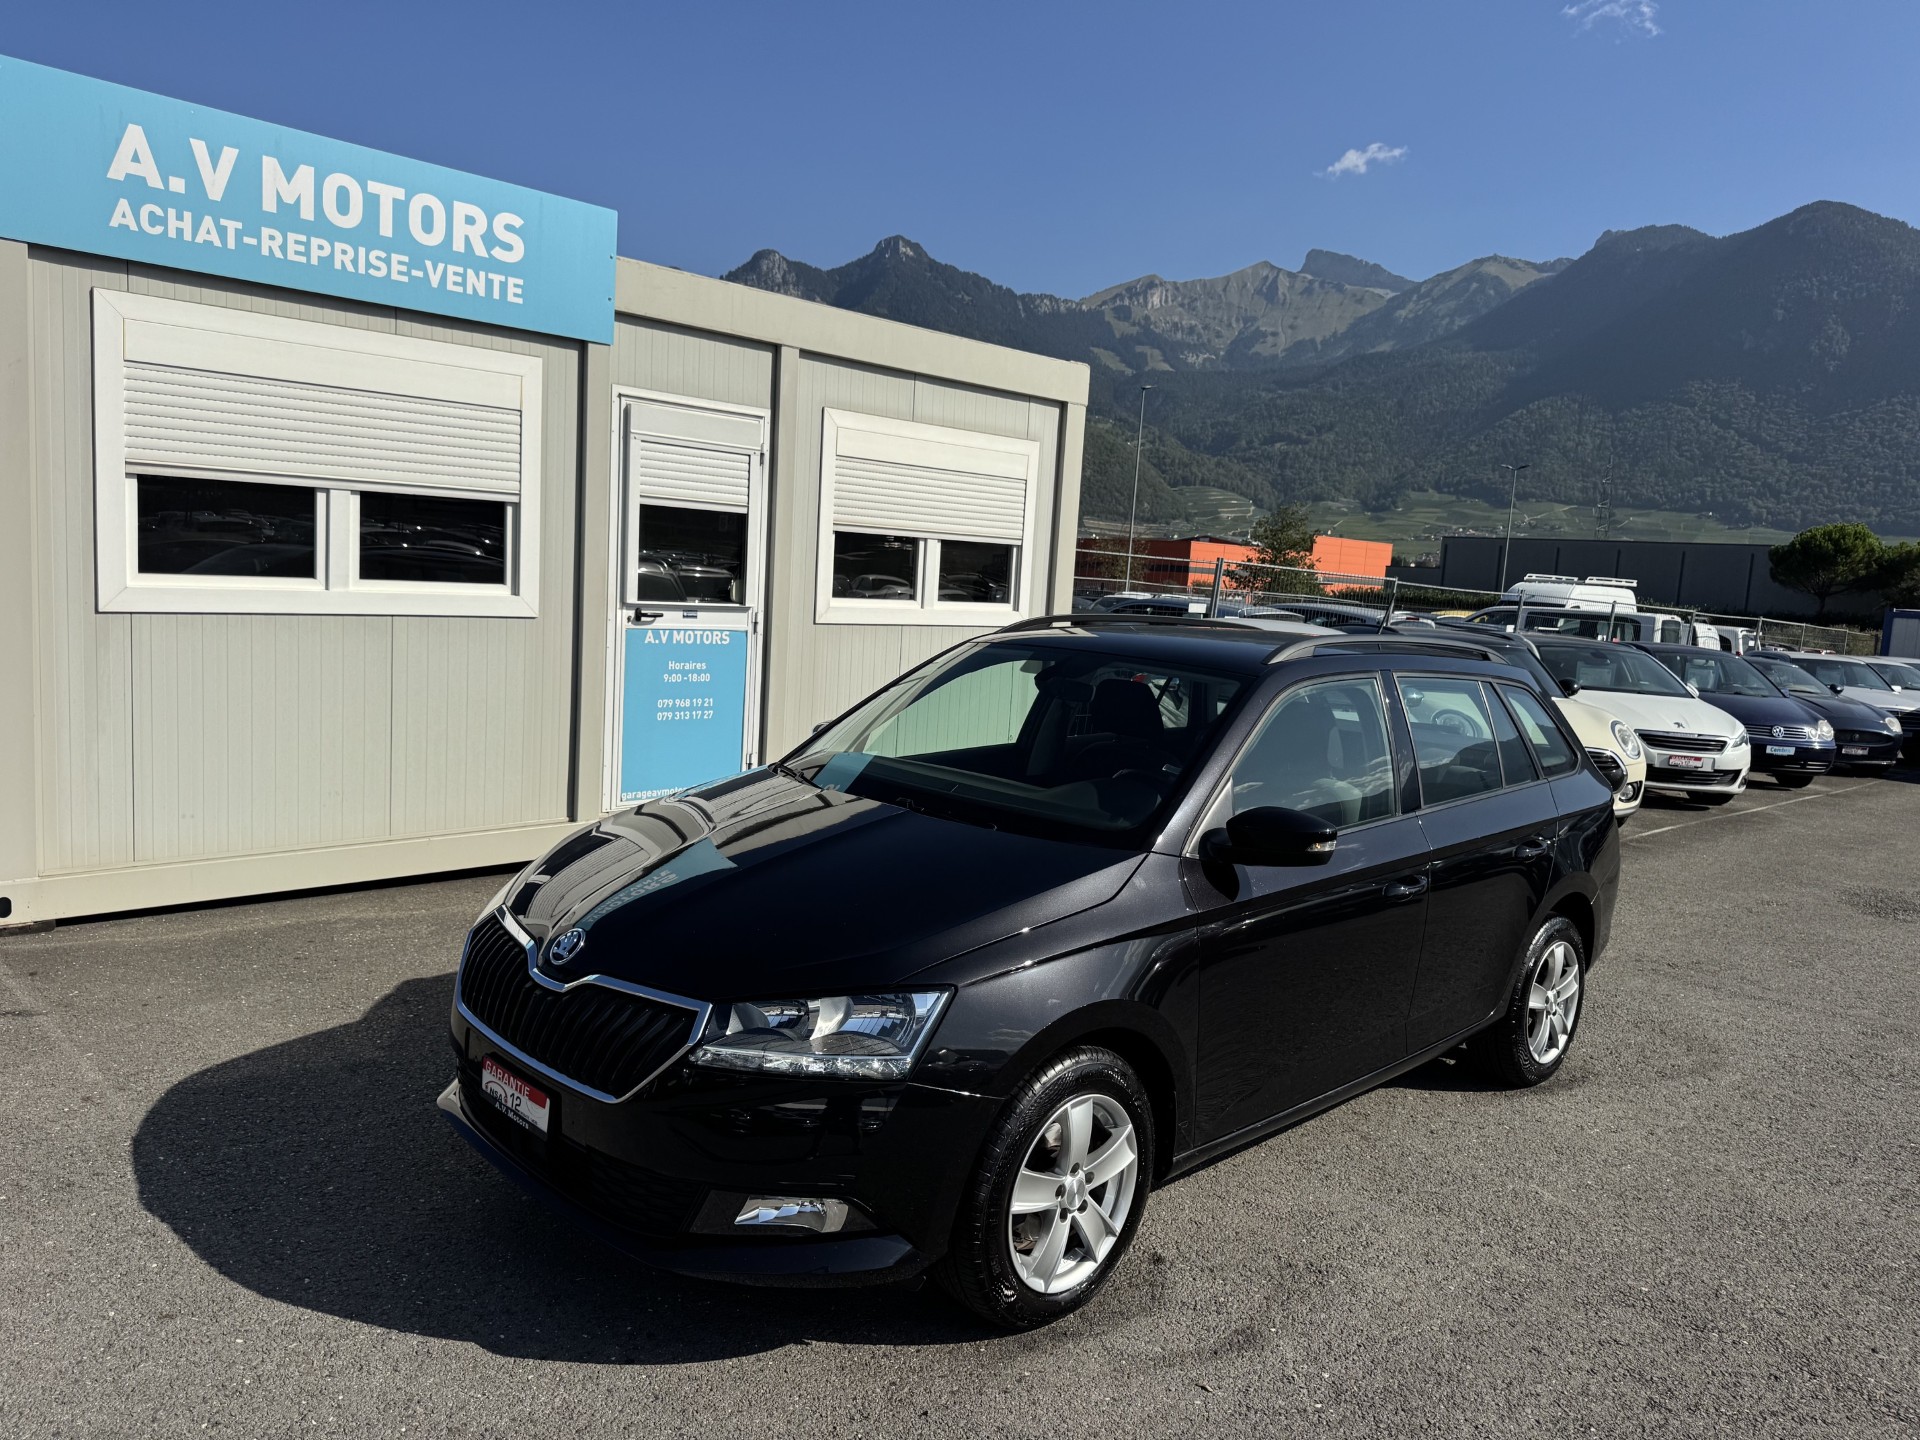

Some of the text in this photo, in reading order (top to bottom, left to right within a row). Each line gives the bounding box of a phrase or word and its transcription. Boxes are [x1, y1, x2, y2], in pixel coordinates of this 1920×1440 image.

[106, 123, 525, 262] A.V MOTORS
[109, 198, 524, 304] ACHAT-REPRISE-VENTE
[644, 629, 730, 645] A.V MOTORS
[668, 660, 707, 670] Horaires
[657, 697, 713, 708] 079 968 19 21
[656, 710, 713, 721] 079 313 17 27
[485, 1060, 530, 1097] GARANTIE
[510, 1092, 522, 1113] 12
